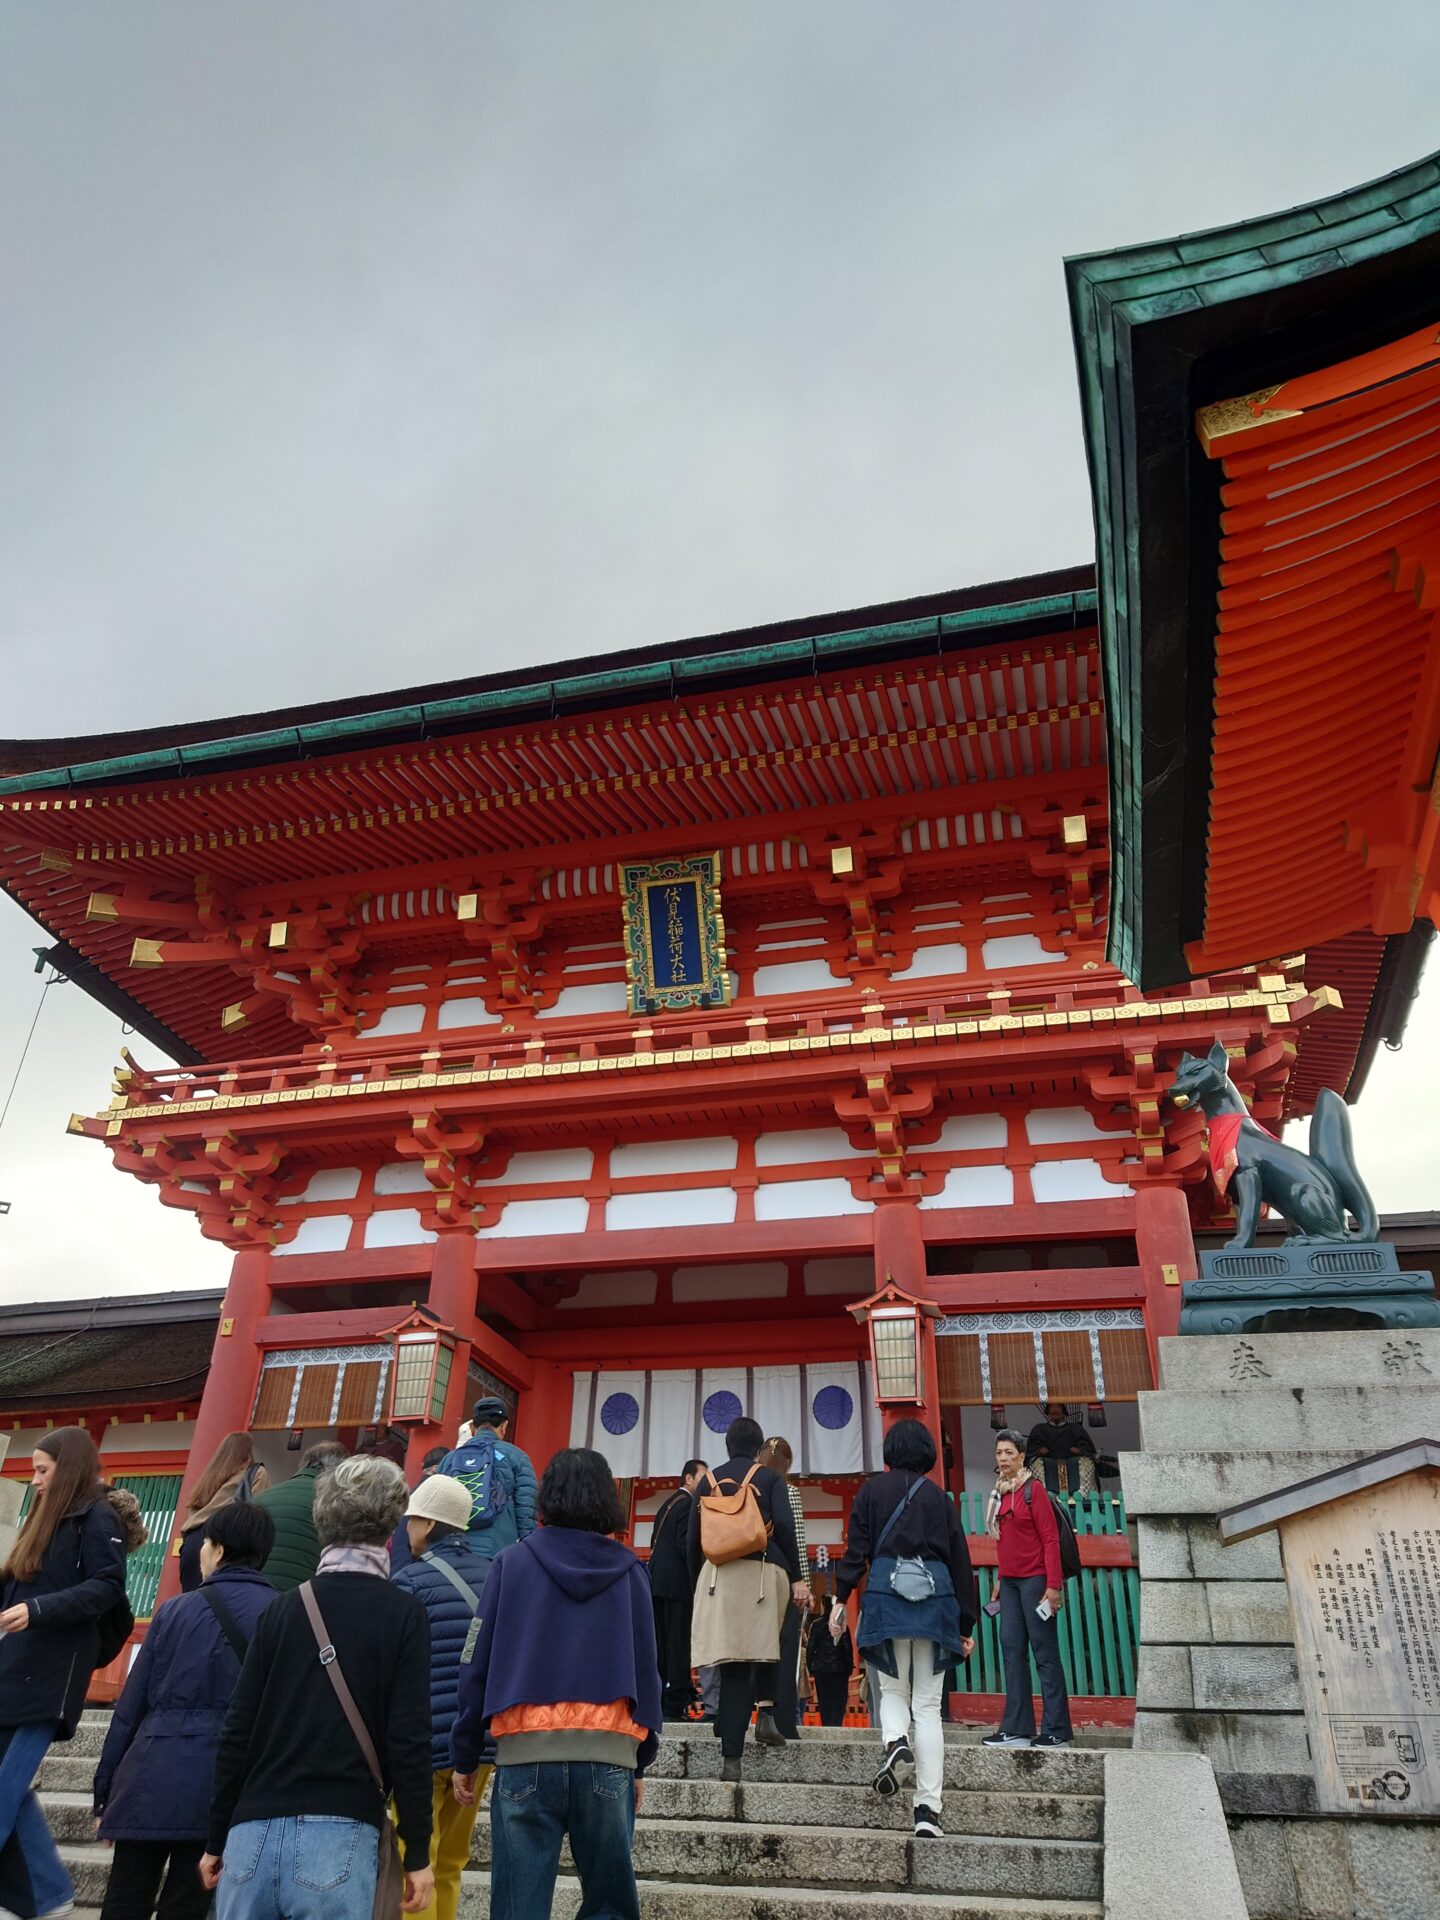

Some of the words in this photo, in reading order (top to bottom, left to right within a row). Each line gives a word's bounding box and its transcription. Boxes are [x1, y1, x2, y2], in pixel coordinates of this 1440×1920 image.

[664, 887, 687, 983] 伏見稲荷大社
[1229, 1341, 1272, 1381] 奉
